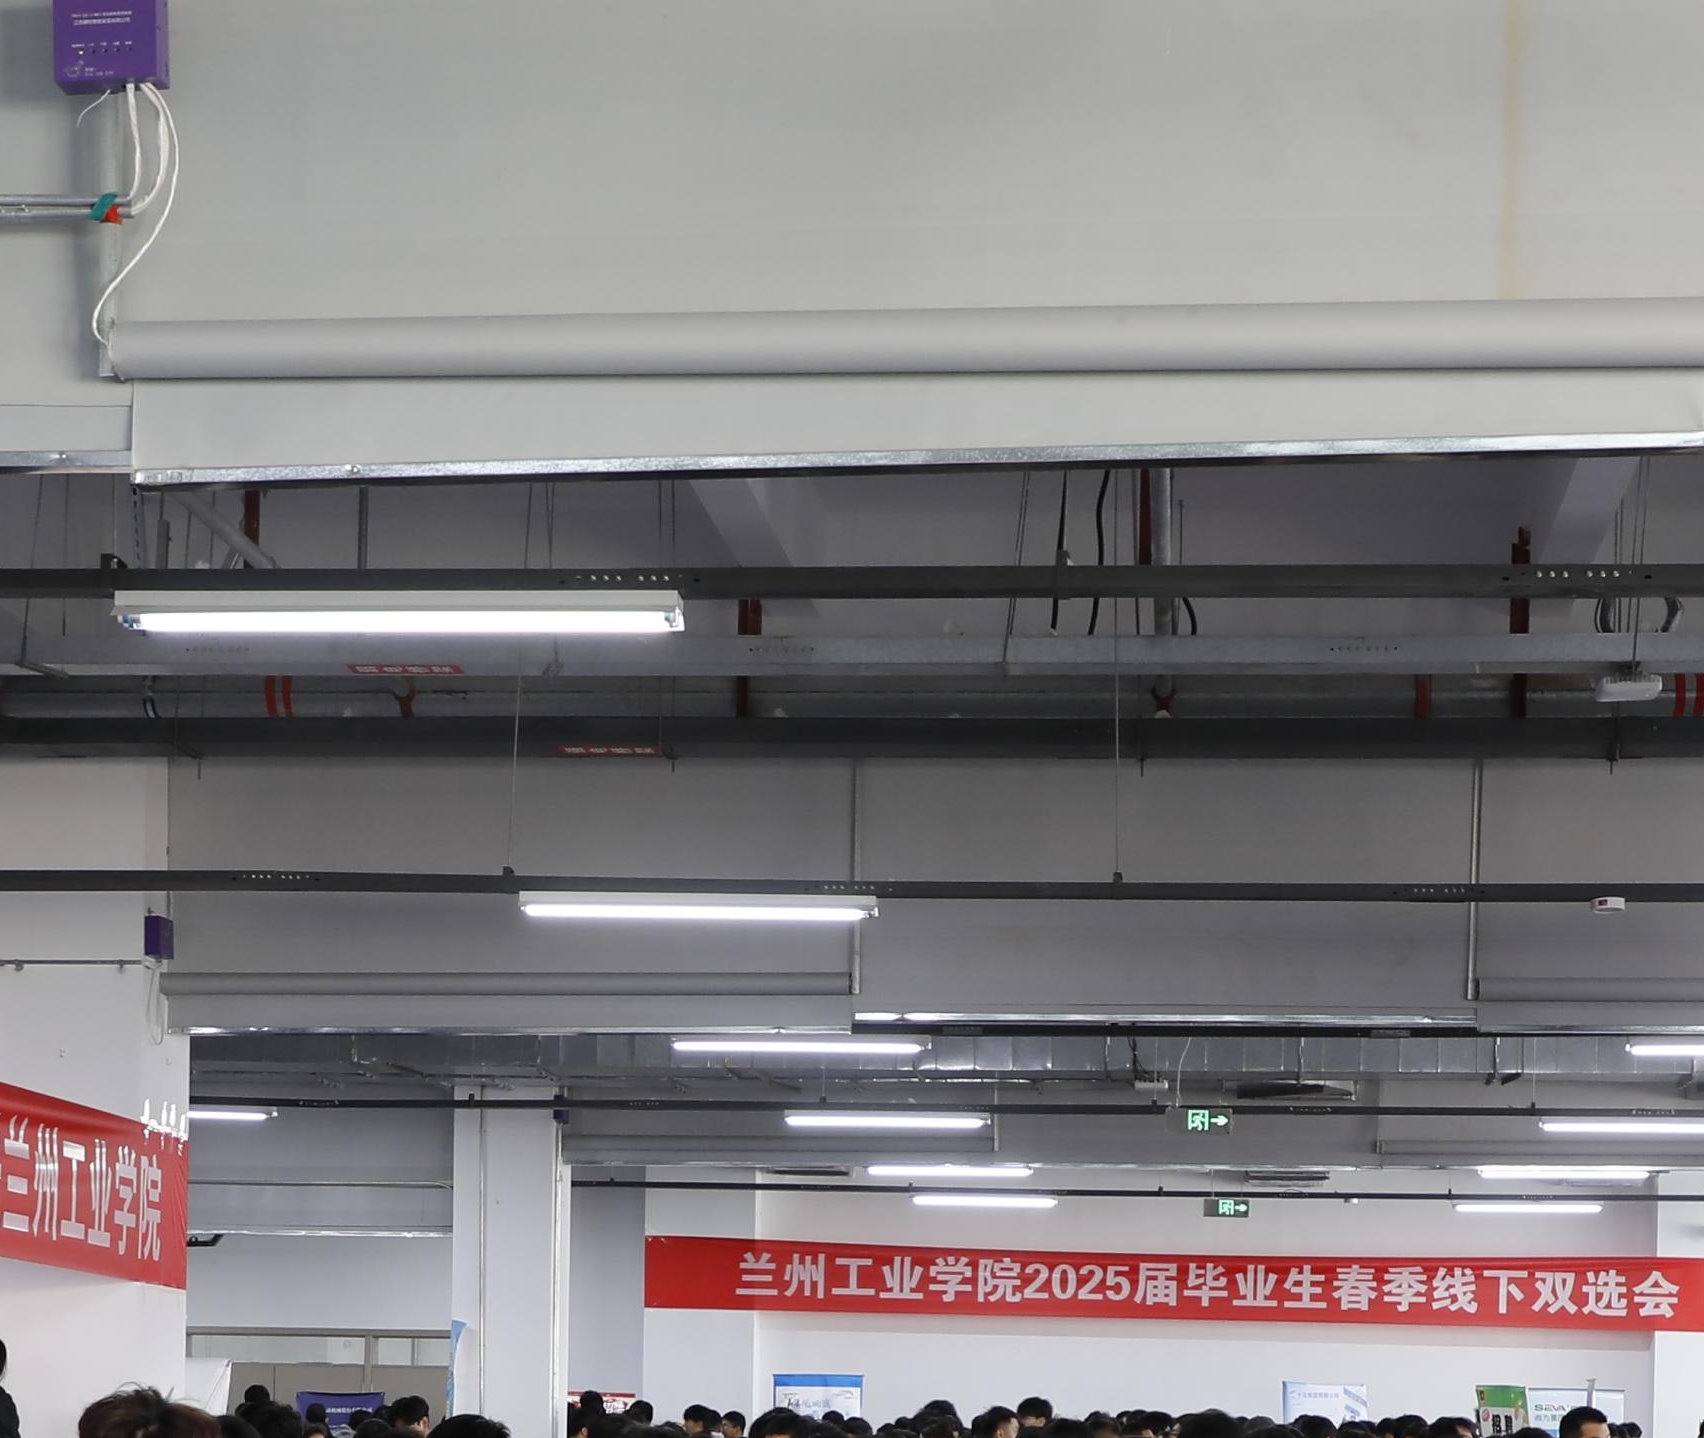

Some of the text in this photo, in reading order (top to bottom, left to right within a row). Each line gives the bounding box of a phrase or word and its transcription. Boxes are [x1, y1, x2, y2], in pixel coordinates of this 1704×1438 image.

[735, 1251, 1681, 1319] 兰州工业学院2025届毕业生春季线下双选会
